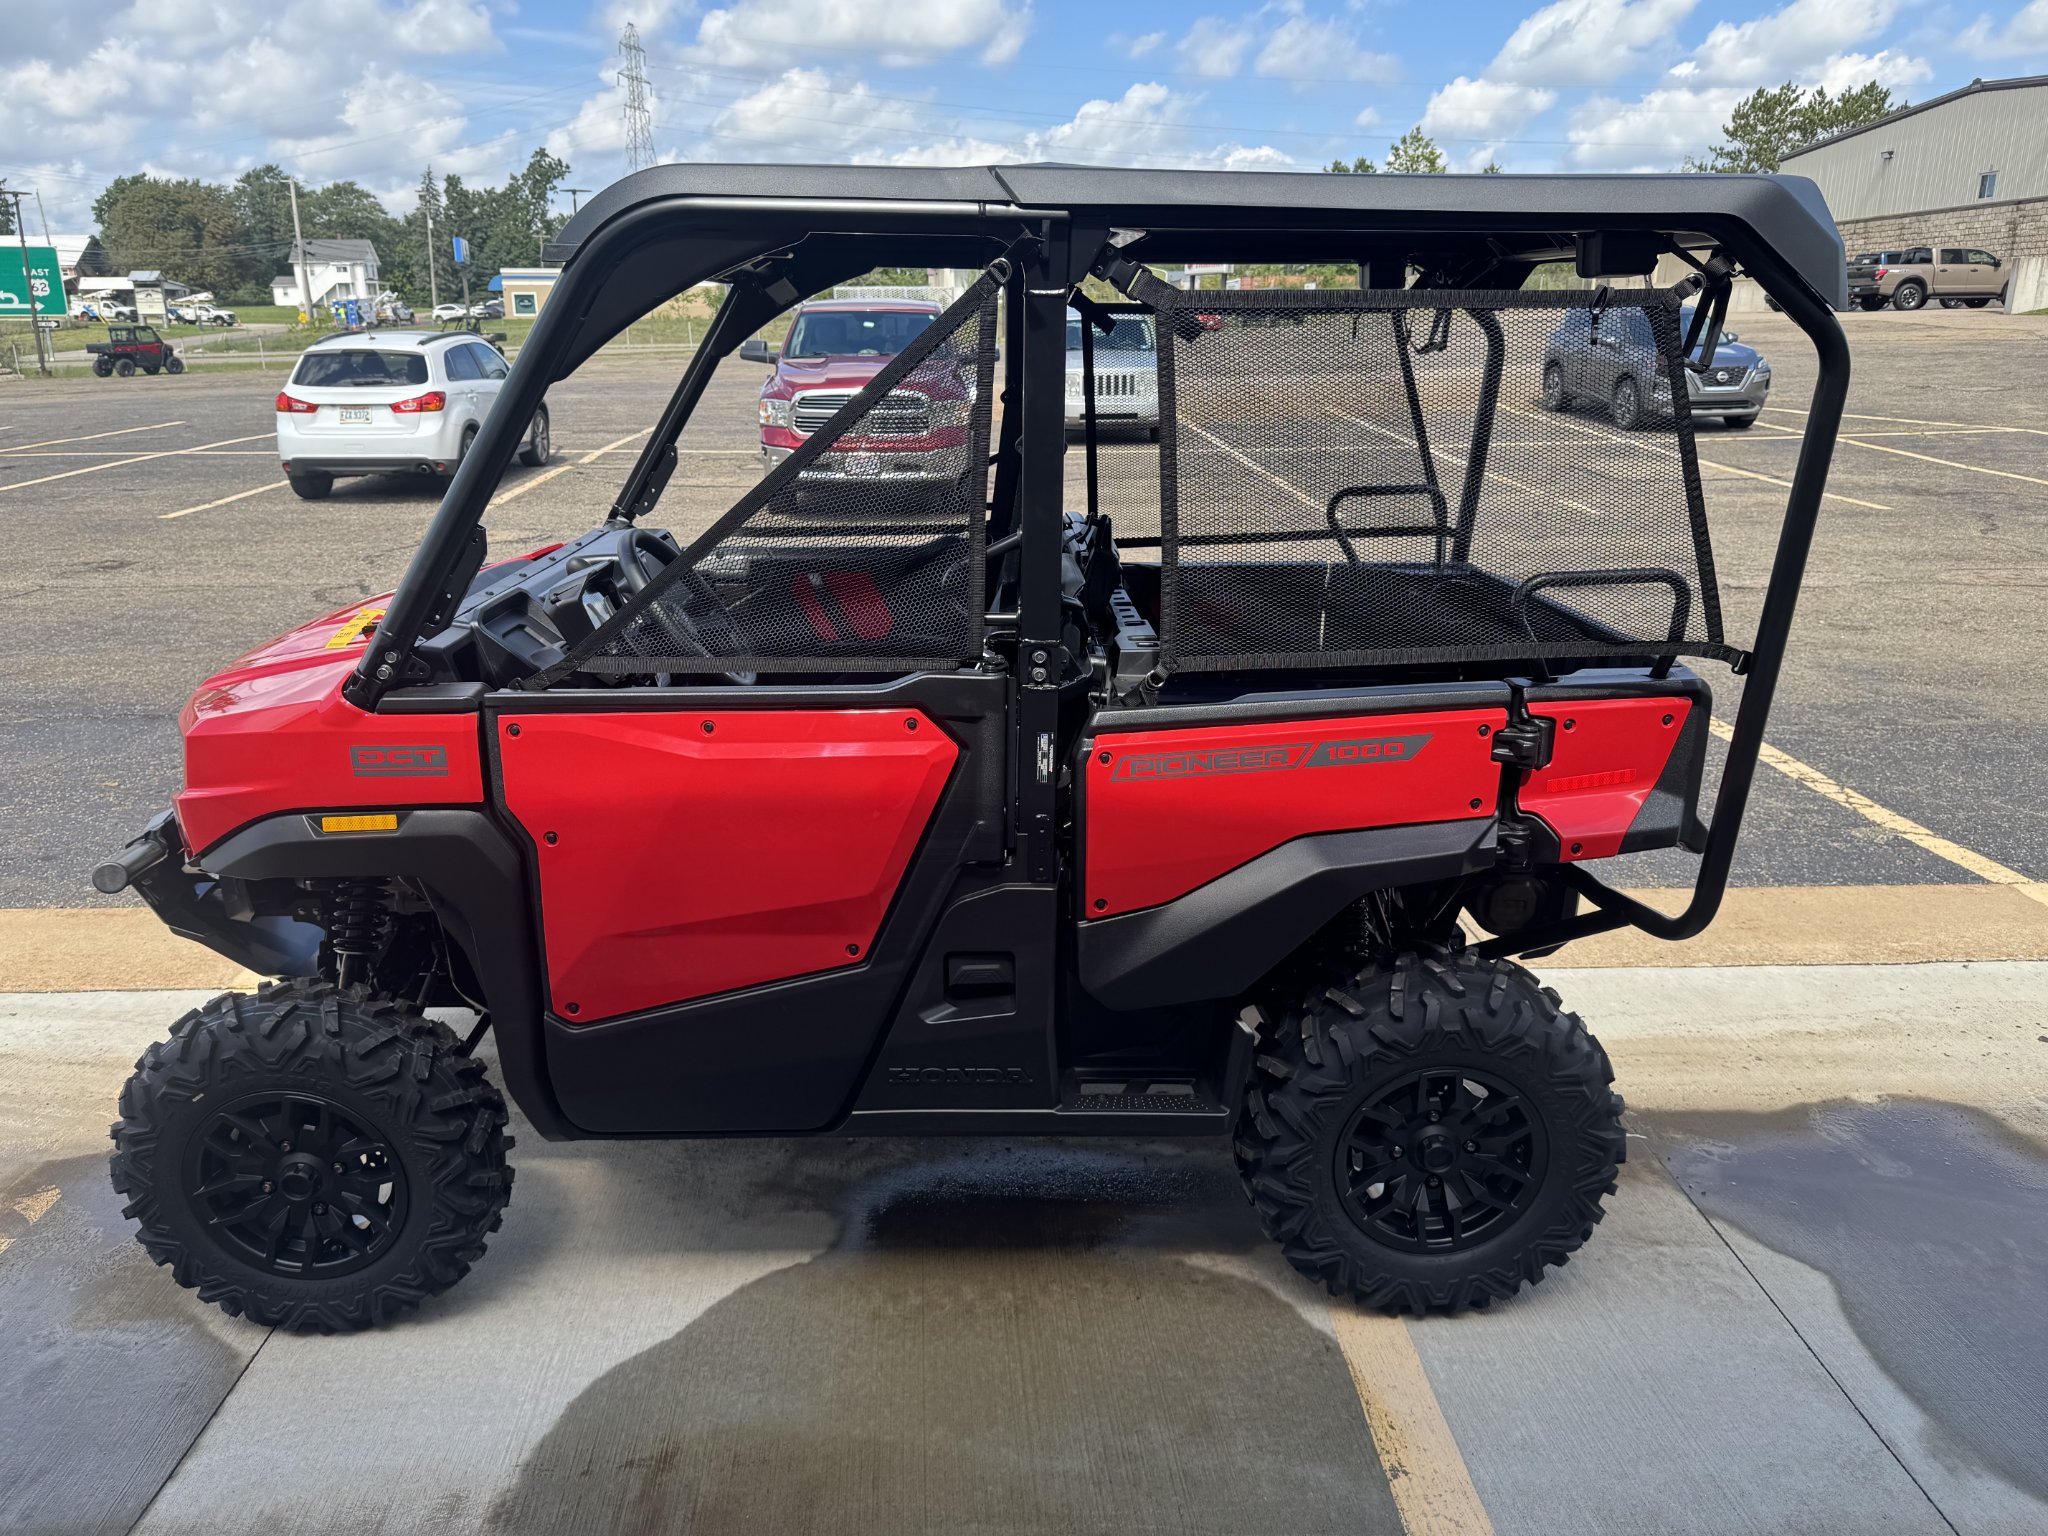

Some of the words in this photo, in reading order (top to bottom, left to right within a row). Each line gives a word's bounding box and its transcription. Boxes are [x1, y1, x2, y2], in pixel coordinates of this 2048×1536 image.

[31, 282, 48, 292] 62
[356, 749, 441, 764] DCT
[1129, 749, 1290, 777] PIONEER
[1326, 742, 1406, 761] 1000
[888, 1067, 1034, 1083] HONDA
